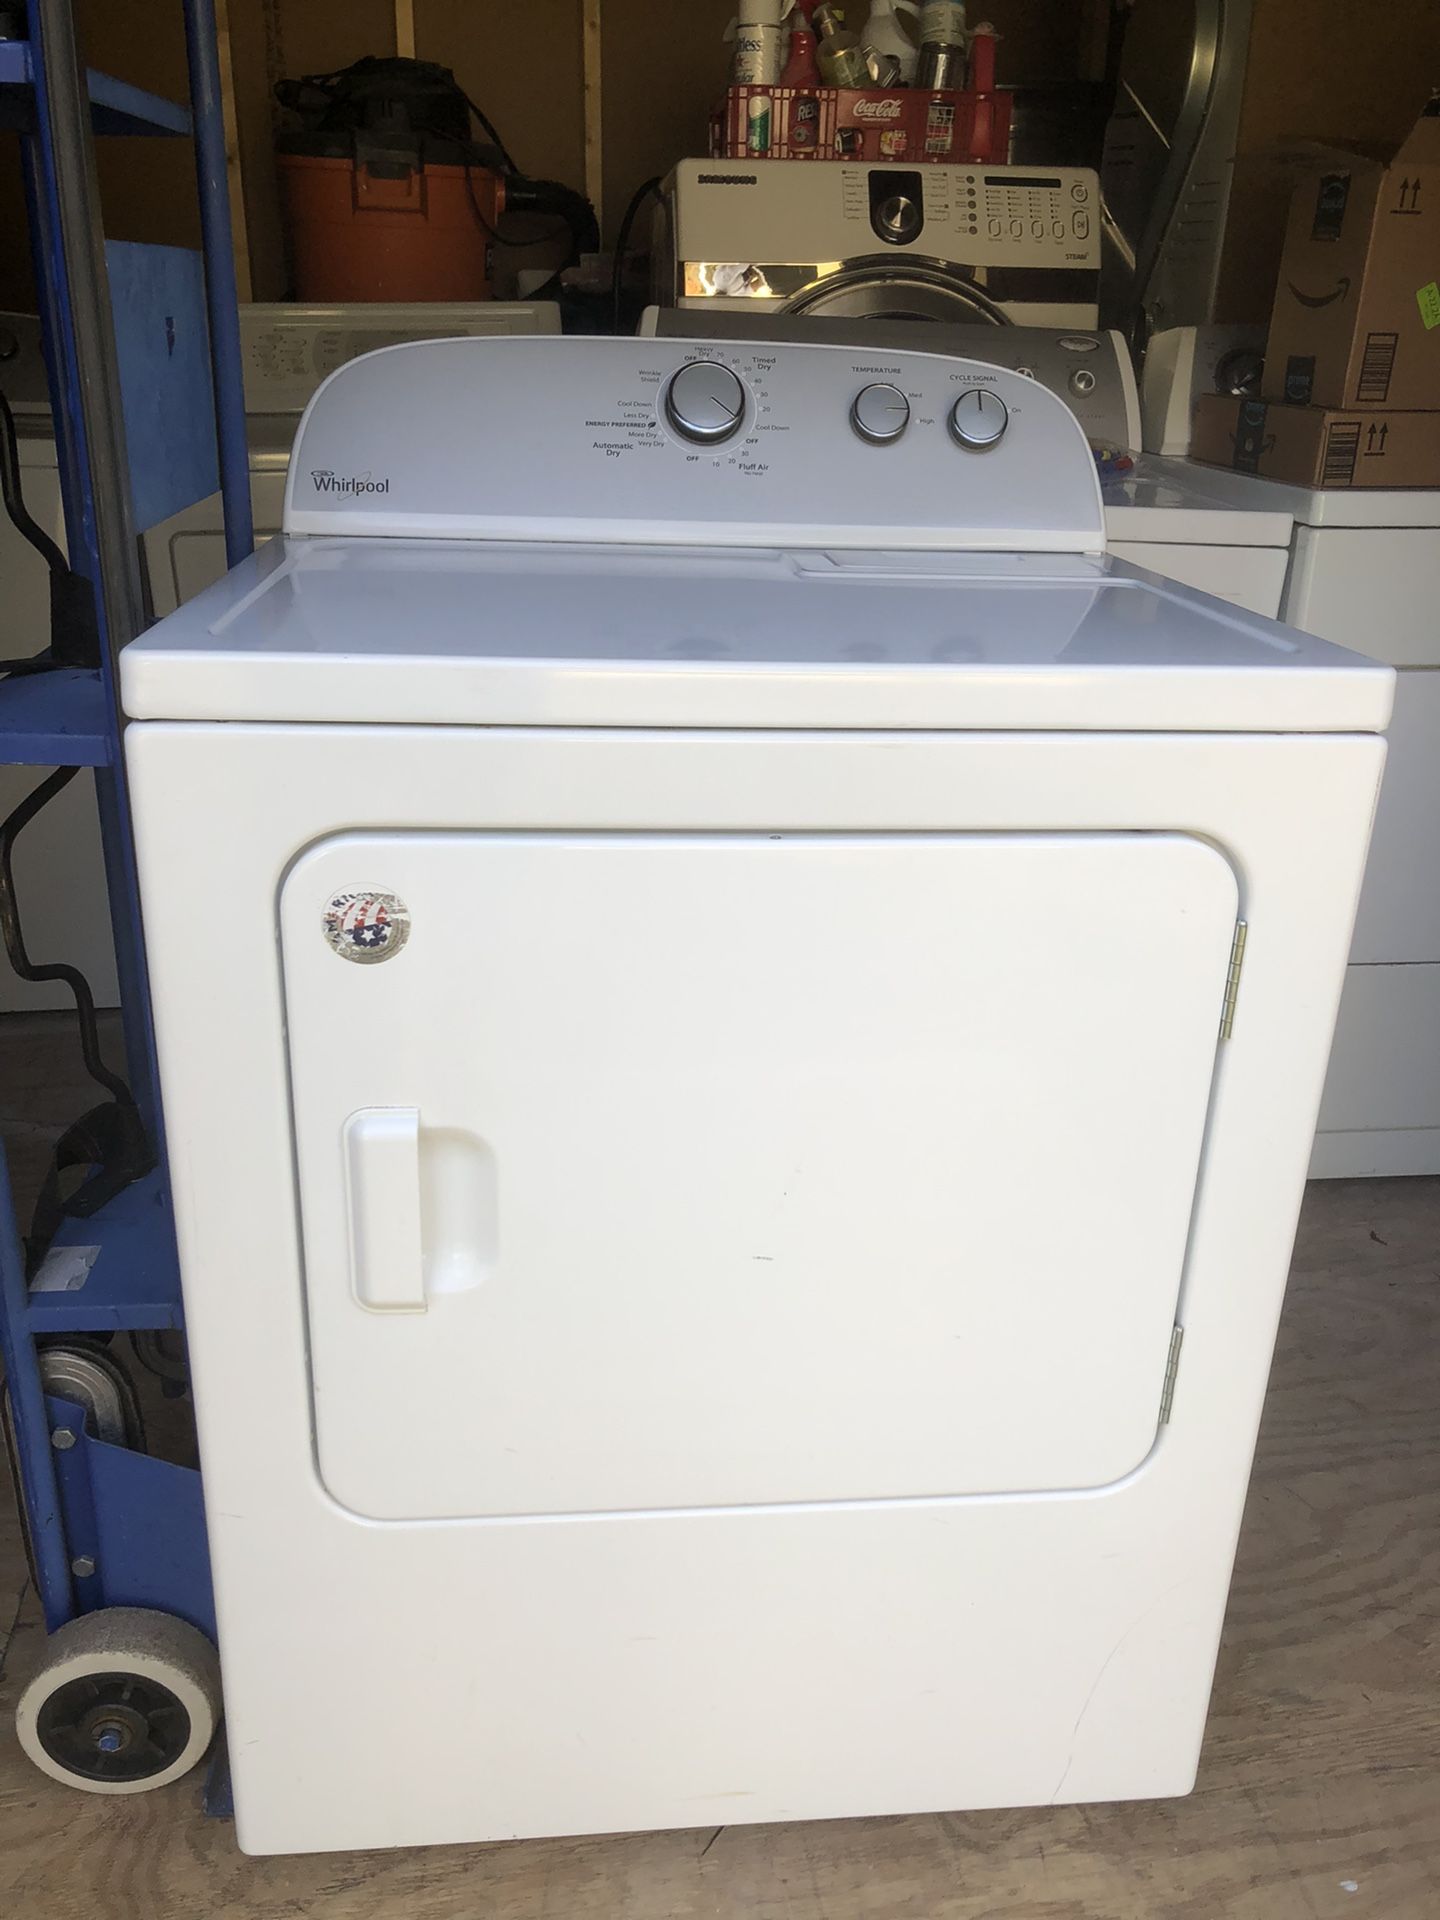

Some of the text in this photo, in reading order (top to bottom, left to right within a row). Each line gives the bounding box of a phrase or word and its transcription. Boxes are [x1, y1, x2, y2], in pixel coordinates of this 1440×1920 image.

[752, 356, 776, 364] Timed
[757, 363, 772, 371] Dry
[851, 366, 902, 374] TEMPERATURE
[949, 374, 998, 383] CYCLE SIGNAL
[592, 441, 634, 450] Automatic
[653, 440, 665, 448] Dry
[606, 449, 621, 458] Dry
[738, 463, 769, 471] Fluff Air
[313, 477, 389, 497] Whirlpool
